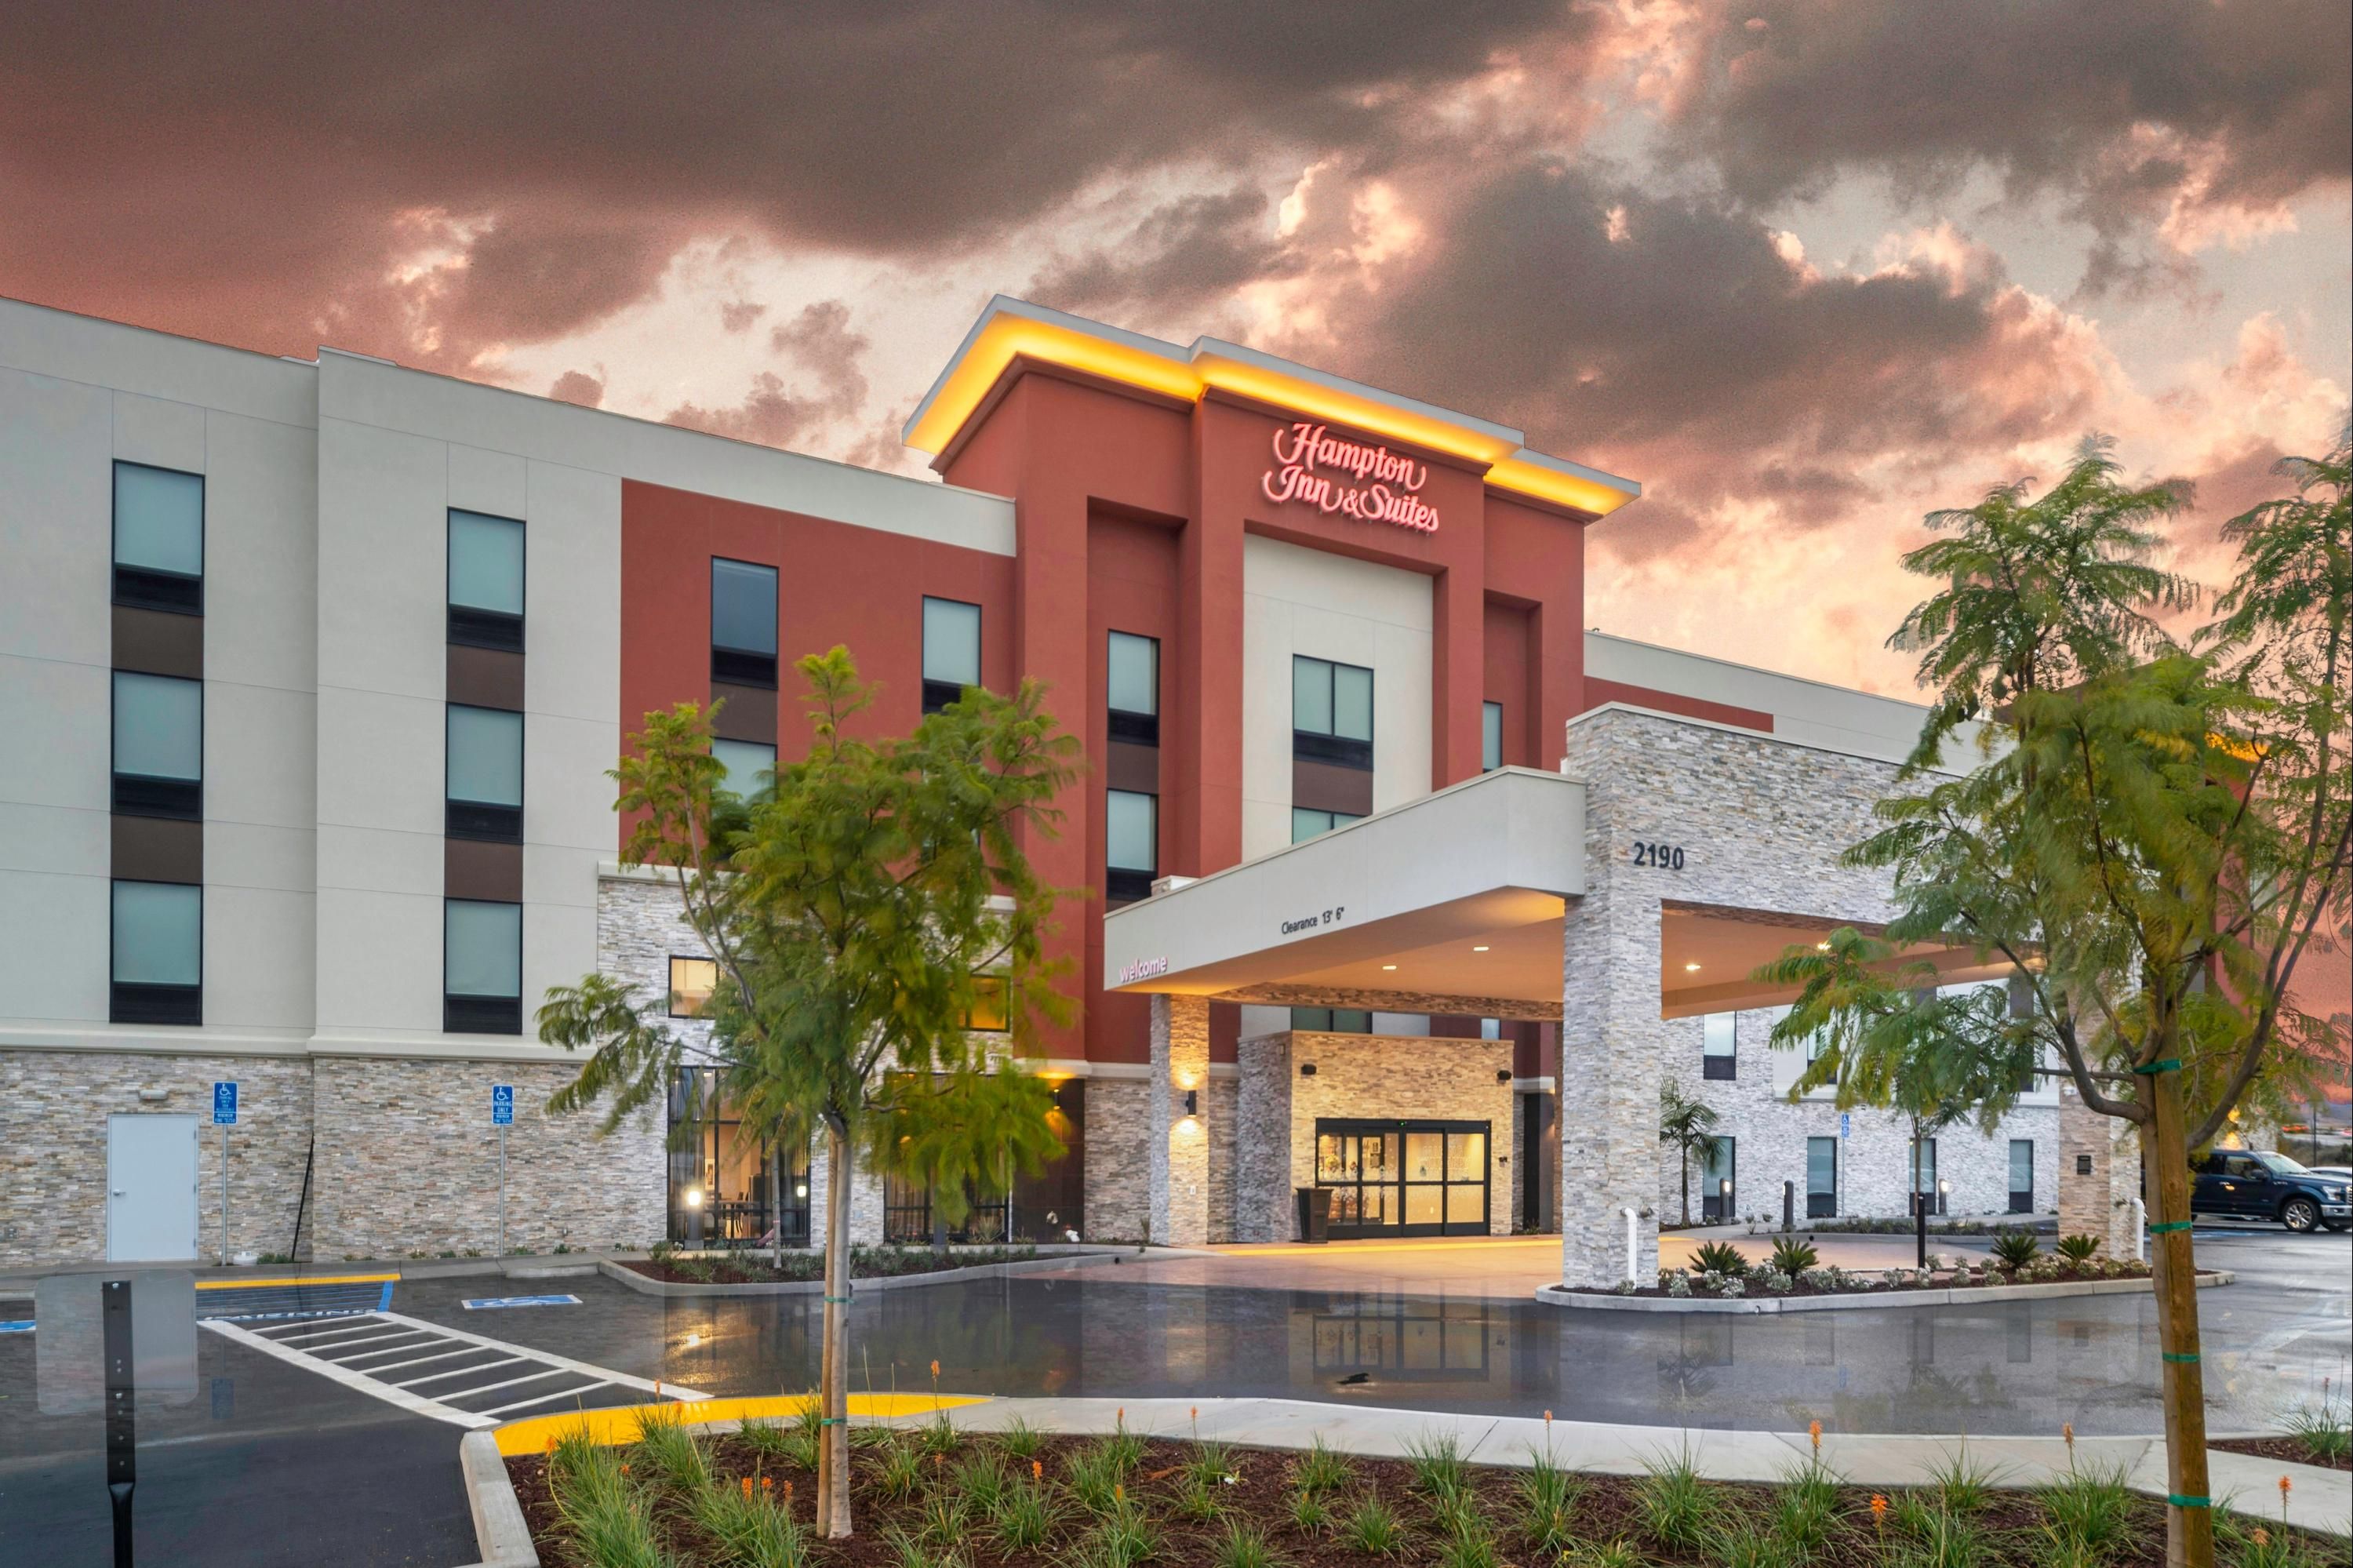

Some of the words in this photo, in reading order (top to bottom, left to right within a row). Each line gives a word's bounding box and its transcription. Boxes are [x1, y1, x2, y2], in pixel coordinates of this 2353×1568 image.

[1273, 423, 1427, 491] Hampton
[1262, 465, 1344, 511] Inn
[1342, 489, 1364, 518] &
[1359, 484, 1438, 532] Suites
[1634, 842, 1684, 870] 2190
[1282, 916, 1318, 934] Clearance
[1120, 956, 1168, 983] welcome
